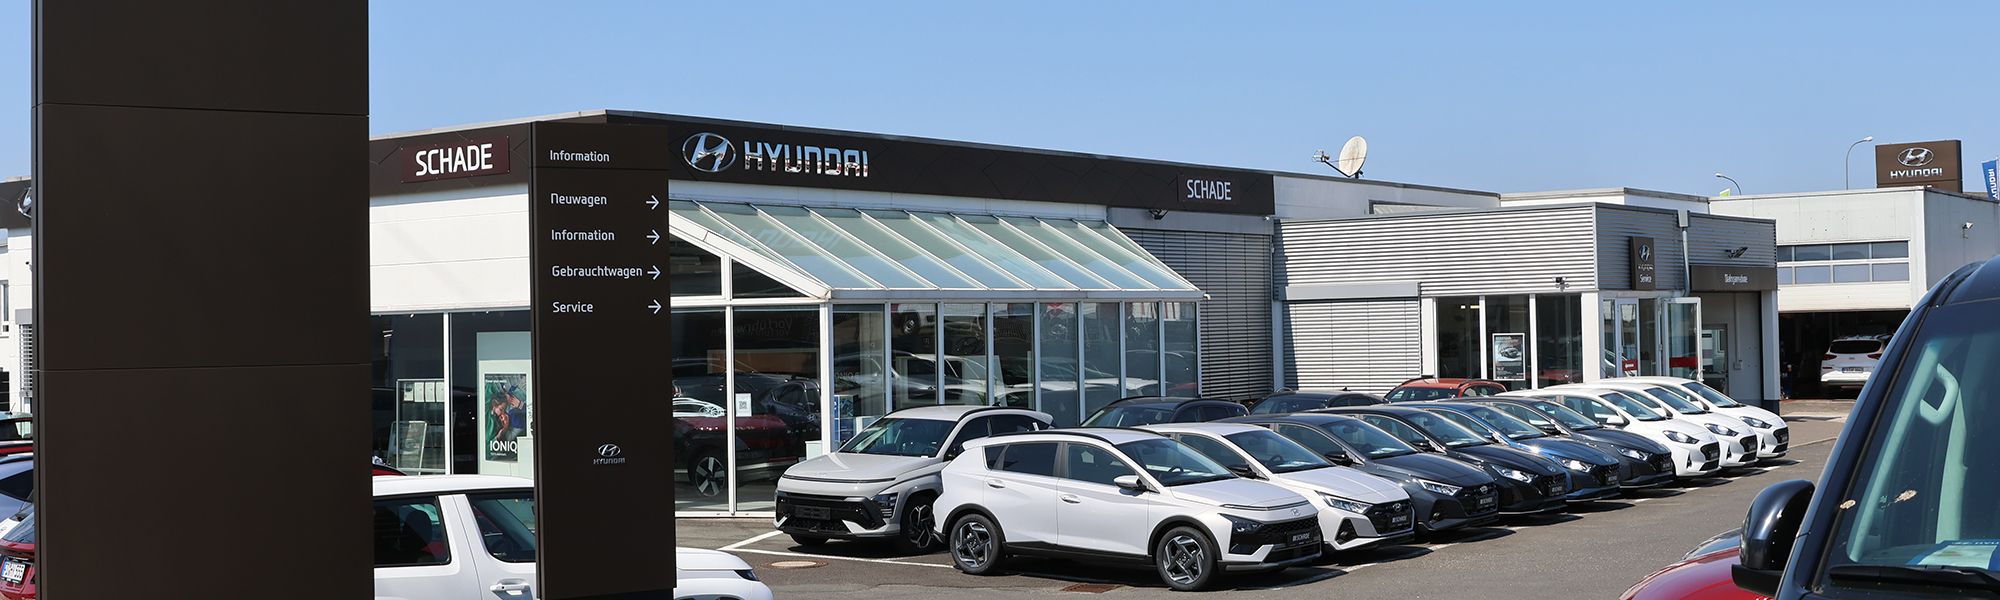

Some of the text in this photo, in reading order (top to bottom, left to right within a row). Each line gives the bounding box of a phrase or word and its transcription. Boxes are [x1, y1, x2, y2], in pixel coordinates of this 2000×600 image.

[415, 143, 493, 177] SCHADE
[549, 149, 610, 163] Information
[743, 140, 869, 178] HYUNDAI
[1890, 167, 1943, 179] HYUNDAI
[1186, 179, 1232, 201] SCHADE
[550, 192, 608, 208] Neuwagen
[551, 229, 615, 242] Information
[551, 265, 643, 280] Gebrauchtwagen
[552, 301, 594, 314] Service
[489, 439, 518, 456] IONIQ
[593, 457, 626, 465] HYUNDAI
